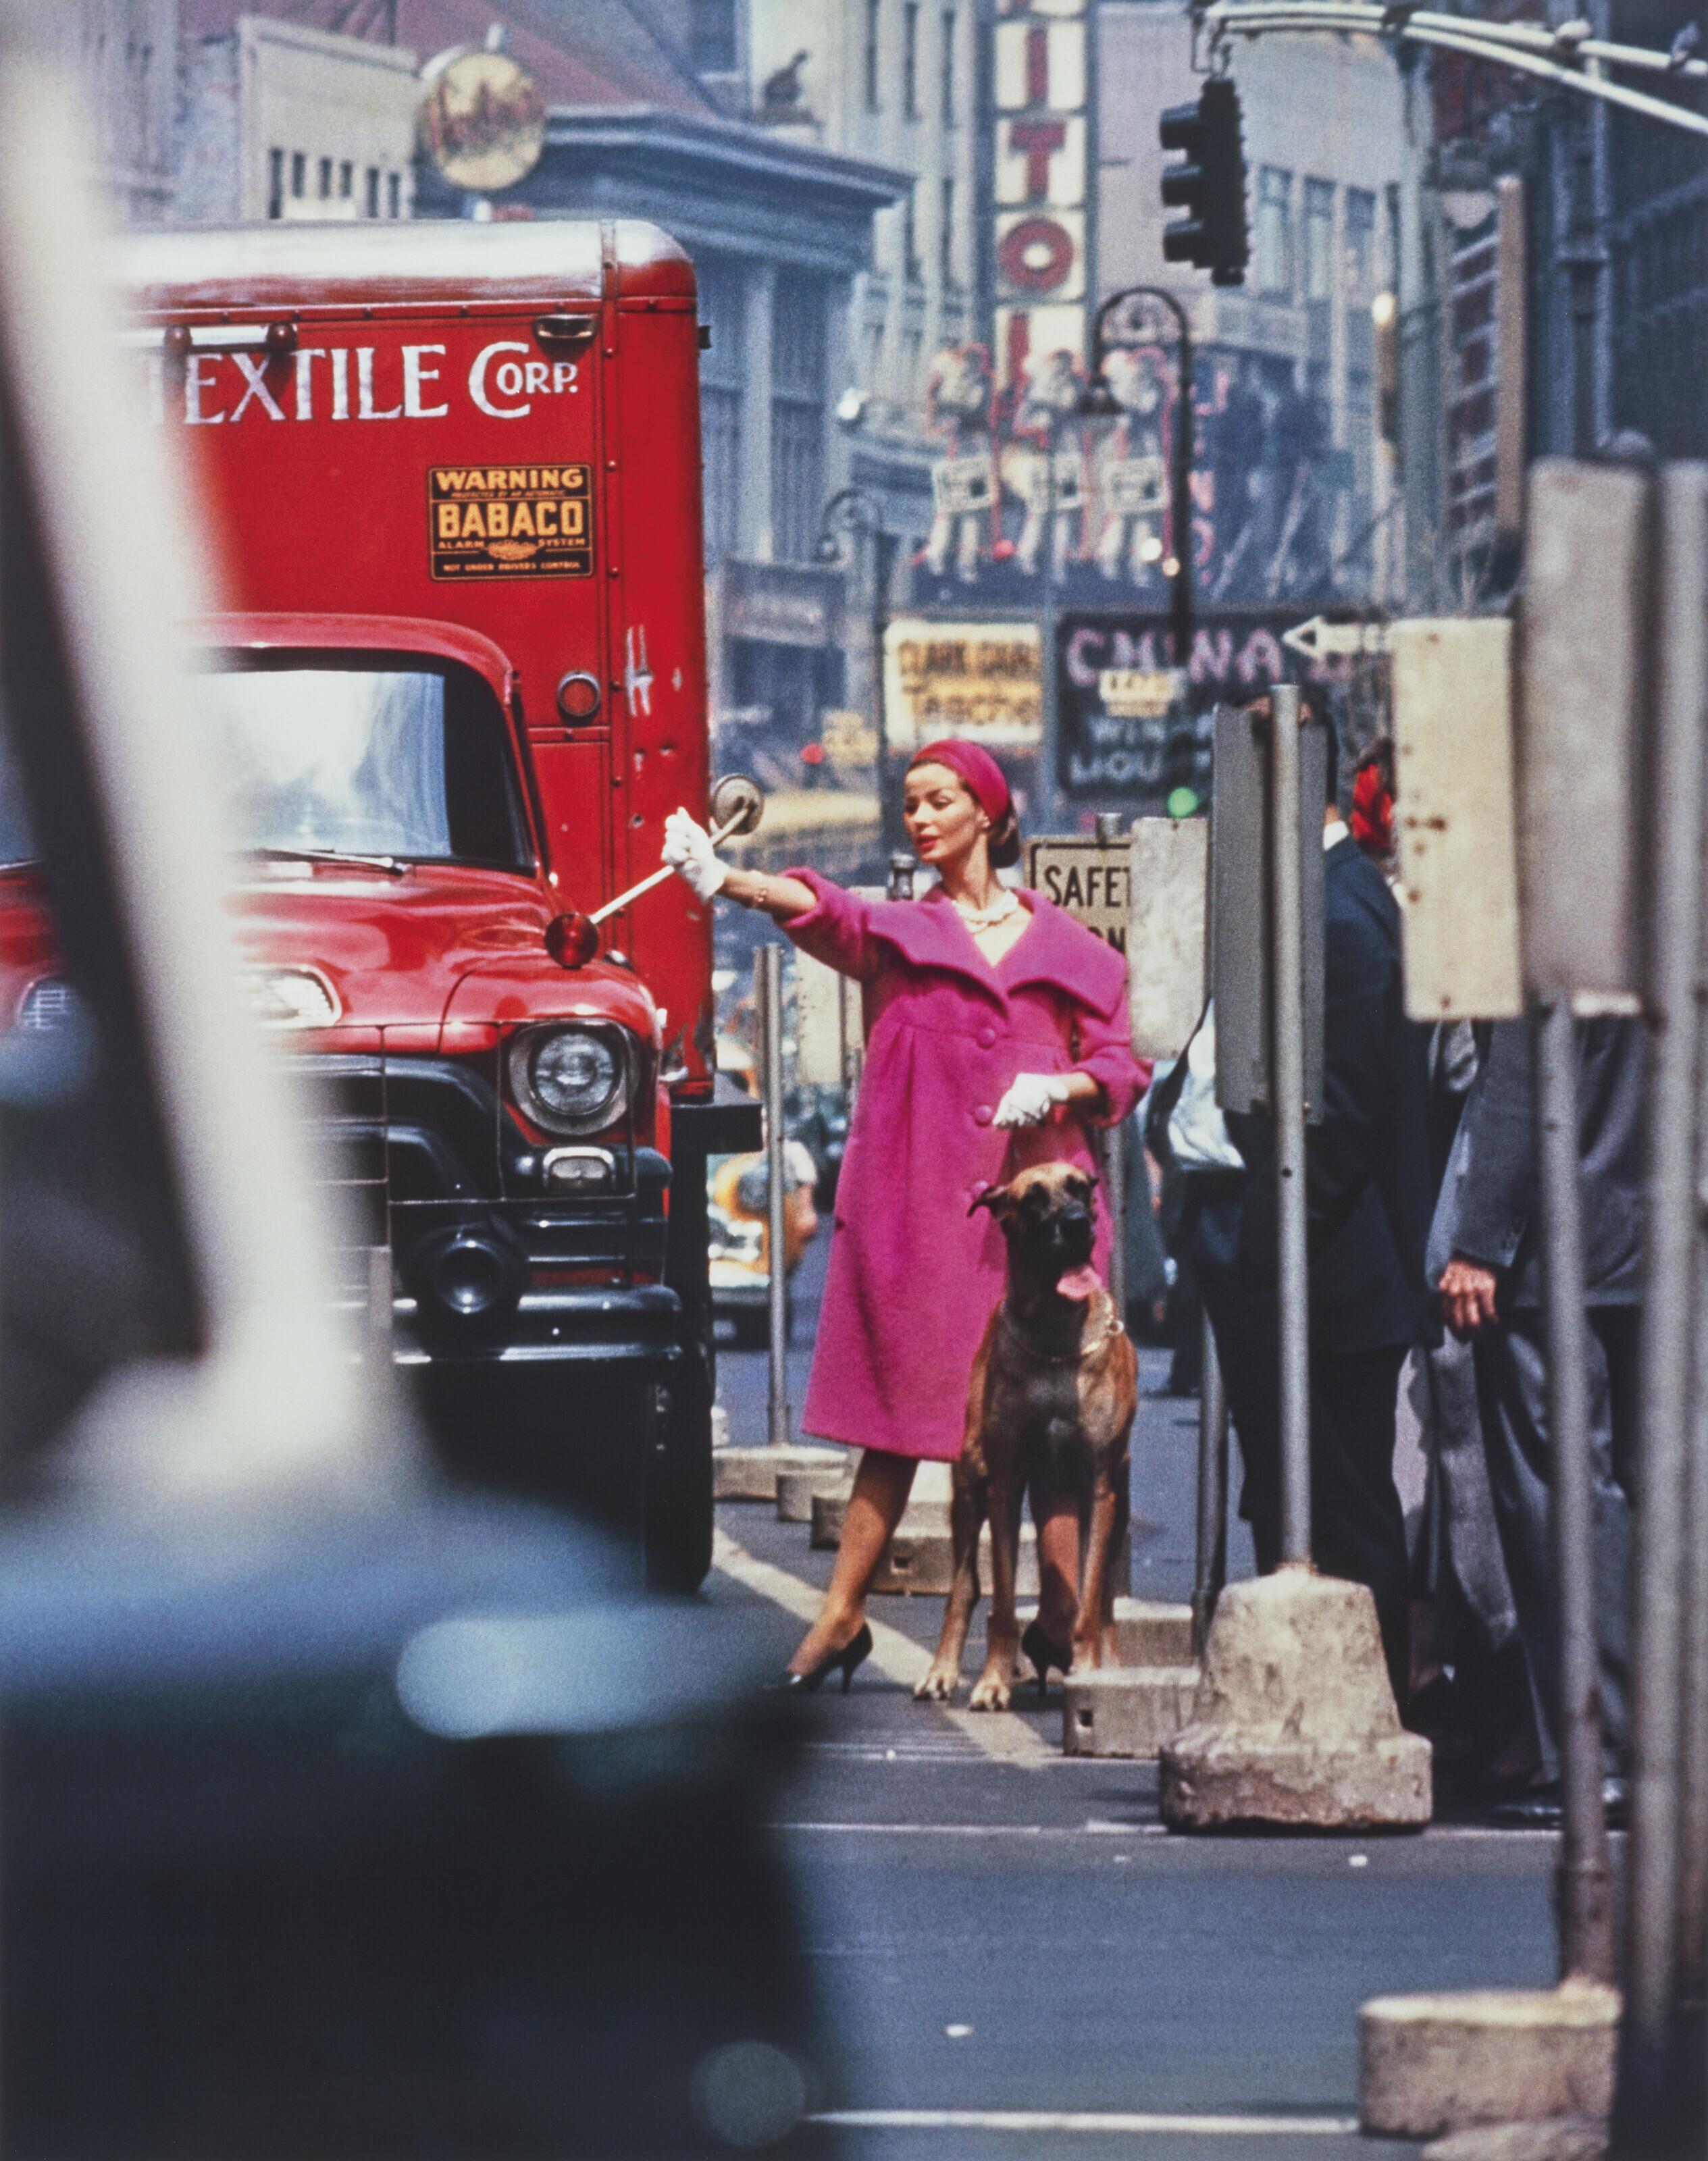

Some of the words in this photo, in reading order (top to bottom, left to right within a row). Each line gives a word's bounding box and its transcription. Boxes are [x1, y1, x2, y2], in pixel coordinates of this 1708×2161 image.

[436, 469, 584, 491] WARNING
[439, 501, 583, 538] BABACO
[438, 540, 485, 549] ALARM
[538, 538, 586, 547] SYSTEM
